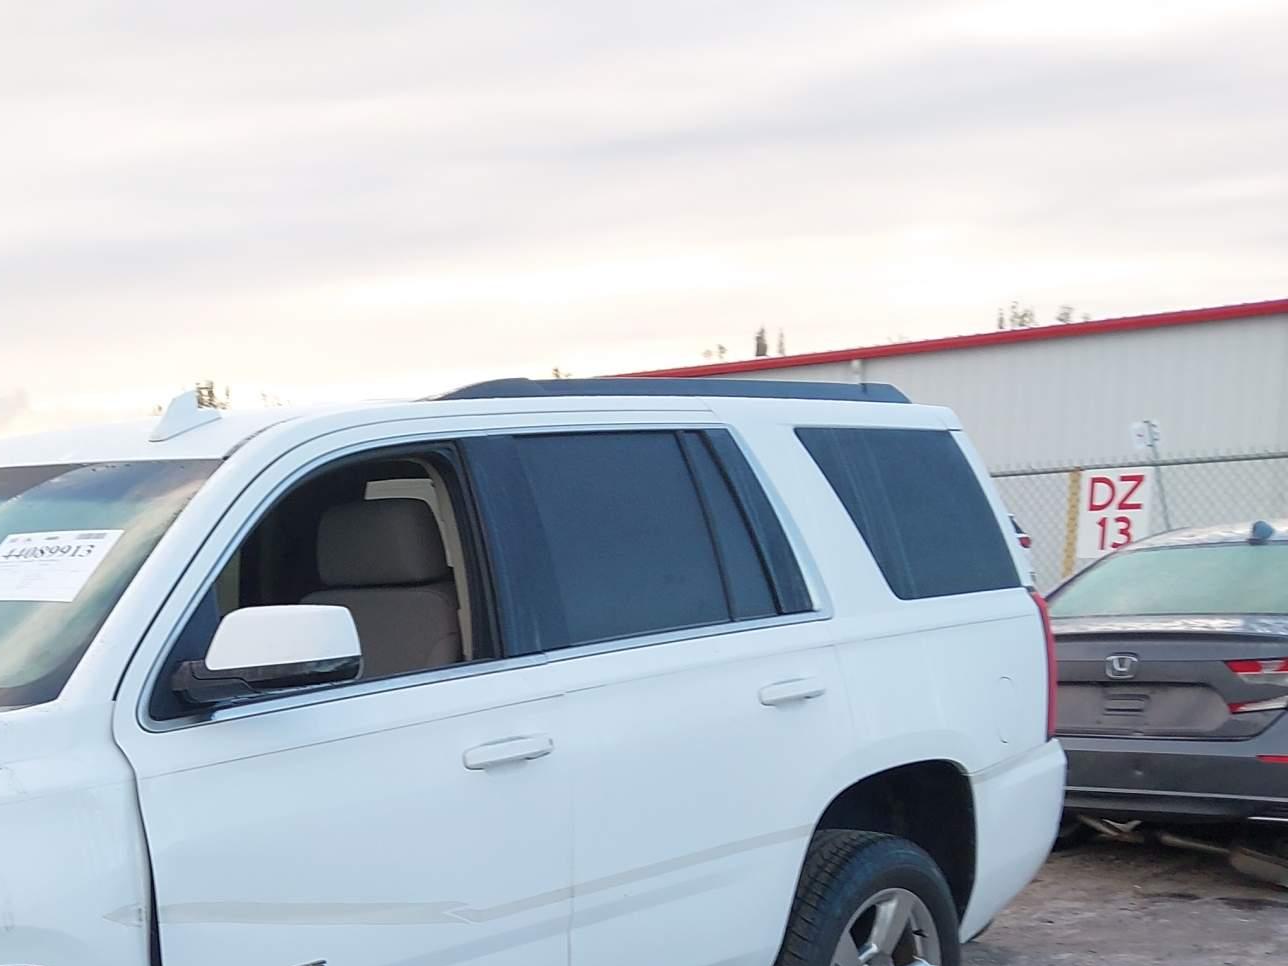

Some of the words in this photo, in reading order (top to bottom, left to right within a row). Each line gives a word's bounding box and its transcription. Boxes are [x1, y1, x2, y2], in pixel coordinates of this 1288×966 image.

[1087, 474, 1145, 512] DZ
[1096, 516, 1133, 550] 13
[0, 543, 96, 559] 44089913
